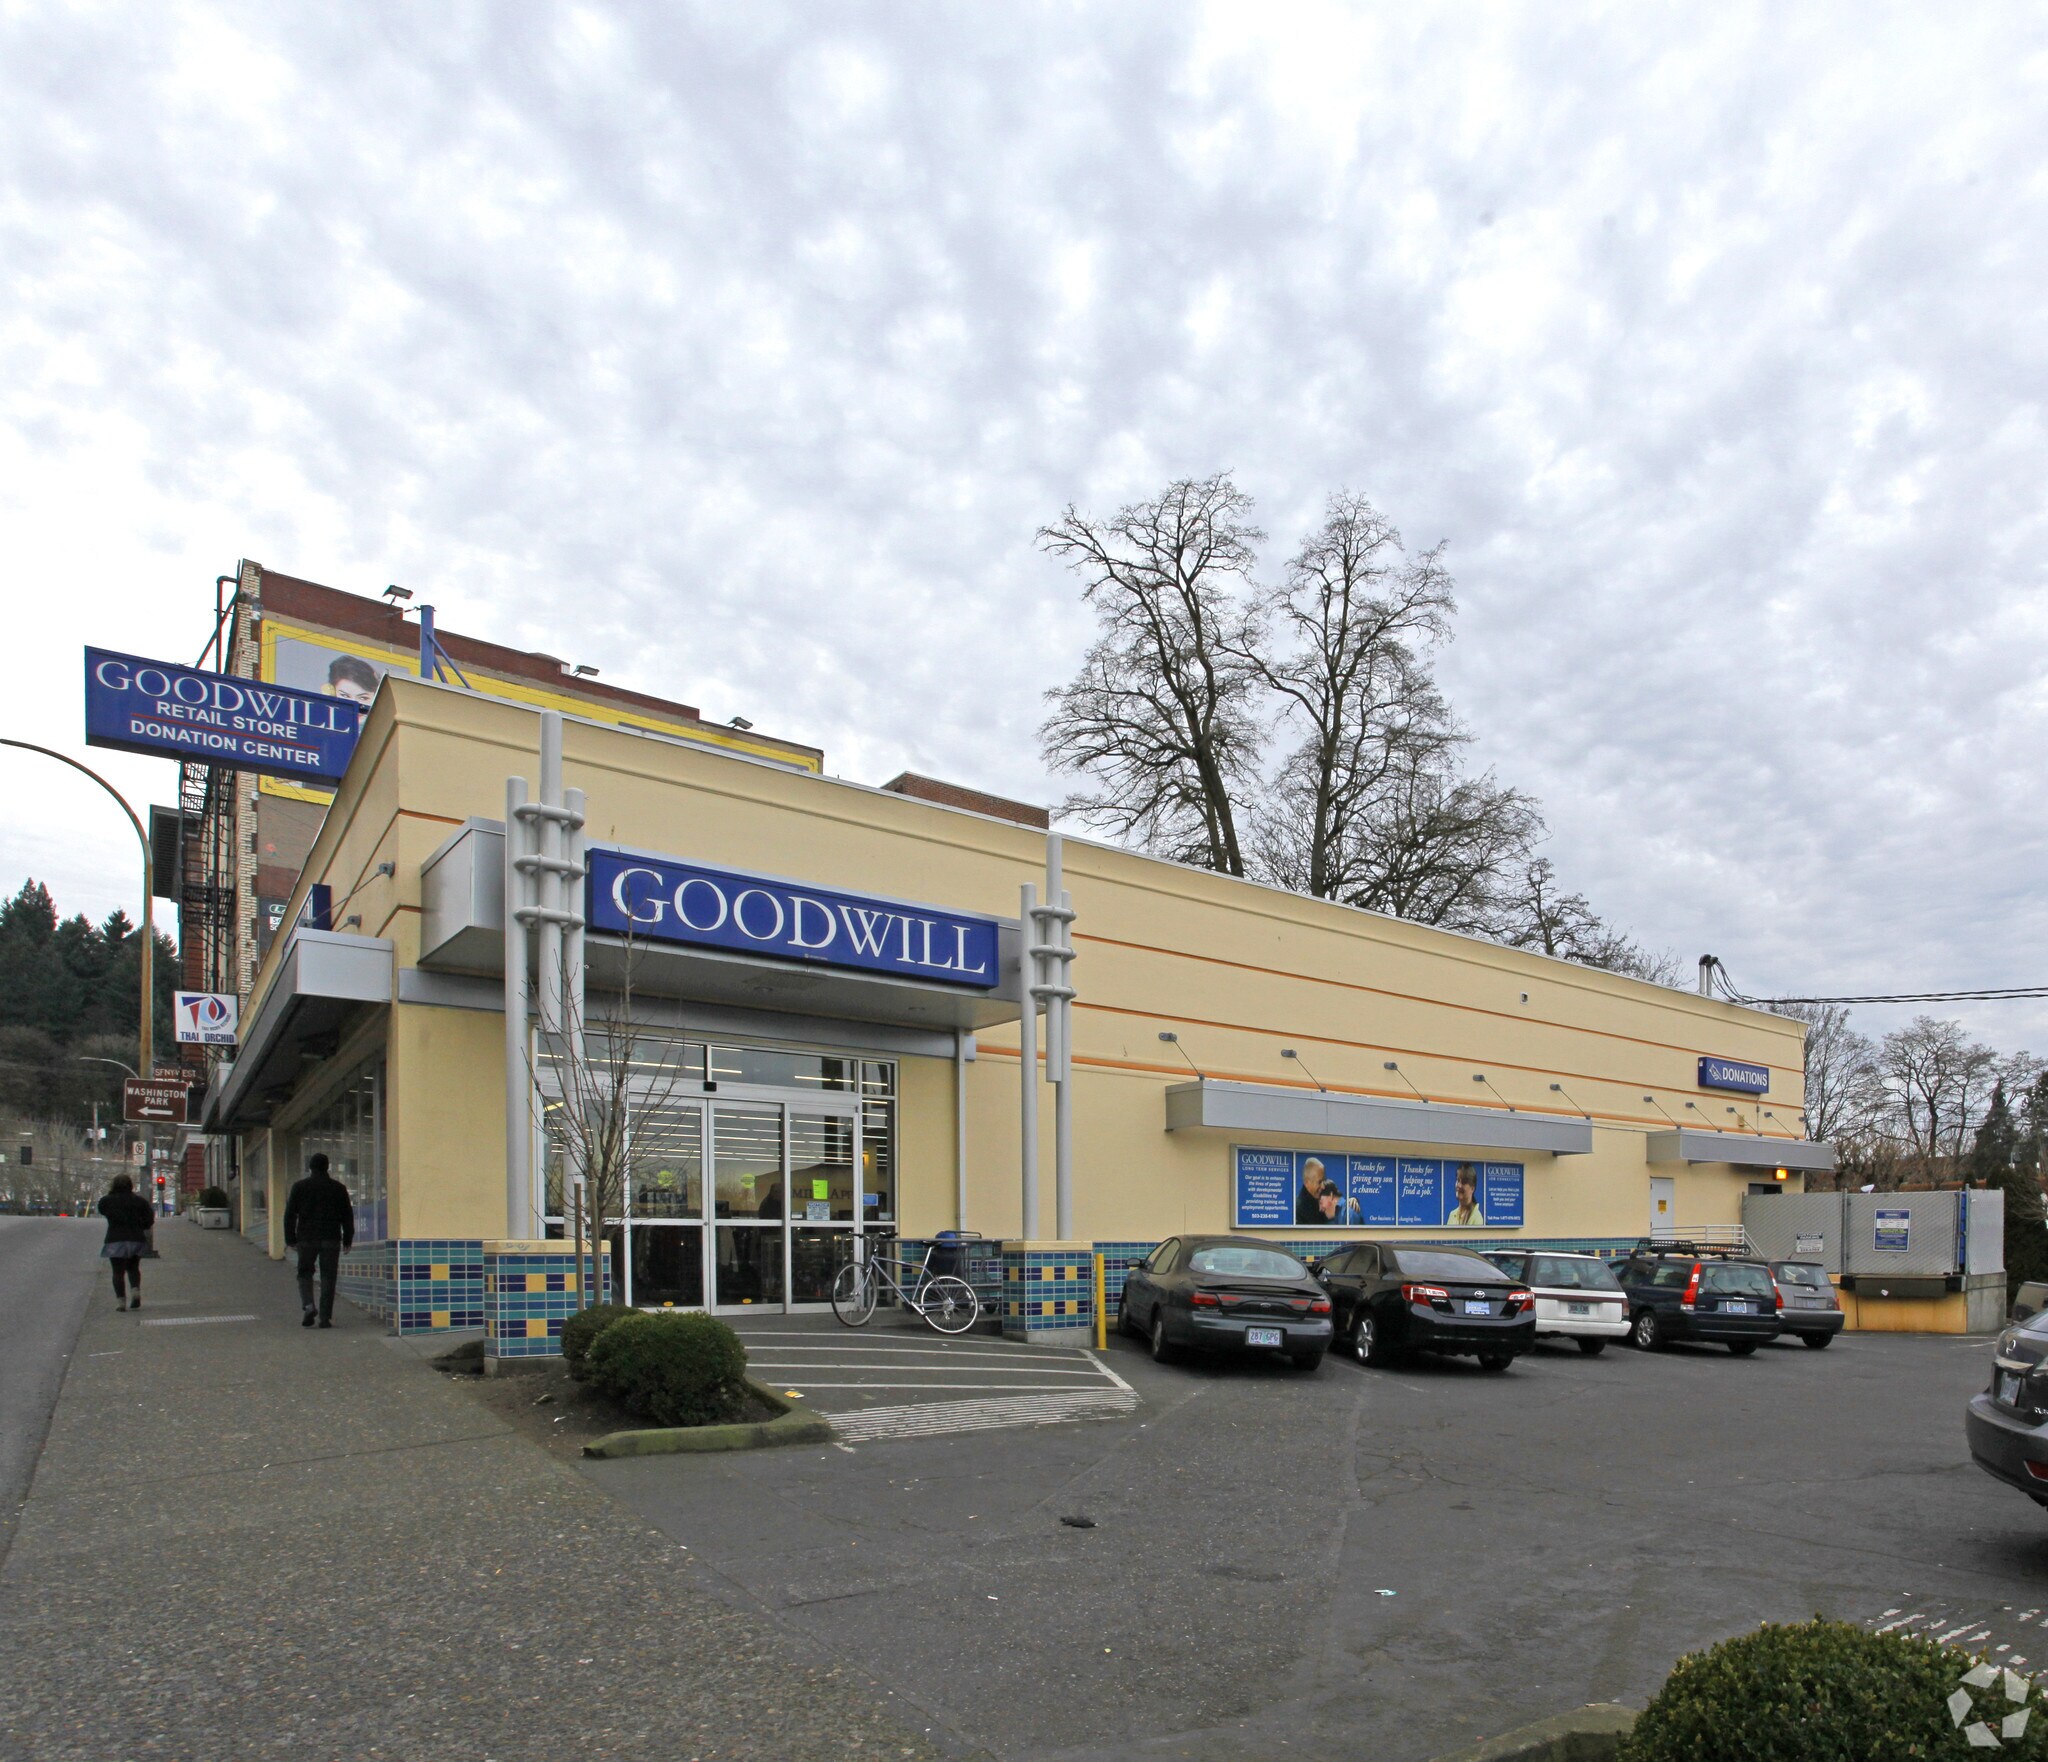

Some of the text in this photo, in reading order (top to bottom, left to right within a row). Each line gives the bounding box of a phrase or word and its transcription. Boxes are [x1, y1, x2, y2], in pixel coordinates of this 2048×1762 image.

[96, 661, 350, 734] GOODWILL
[157, 701, 297, 739] RETAIL STORE
[131, 720, 320, 766] DONATION CENTER
[611, 867, 986, 974] GOODWILL
[180, 1031, 235, 1043] THAI ORCHID
[1722, 1067, 1768, 1087] DONATIONS
[127, 1087, 186, 1099] WASHINGTON
[144, 1096, 169, 1106] PARK
[1242, 1154, 1289, 1165] GOODWILL
[1376, 1162, 1386, 1174] for
[1424, 1165, 1434, 1176] for
[1488, 1167, 1520, 1175] GOODWILL
[1352, 1174, 1372, 1185] giving
[1372, 1176, 1382, 1185] my
[1402, 1174, 1424, 1187] helping
[1402, 1186, 1416, 1198] find
[1250, 1332, 1262, 1340] 287
